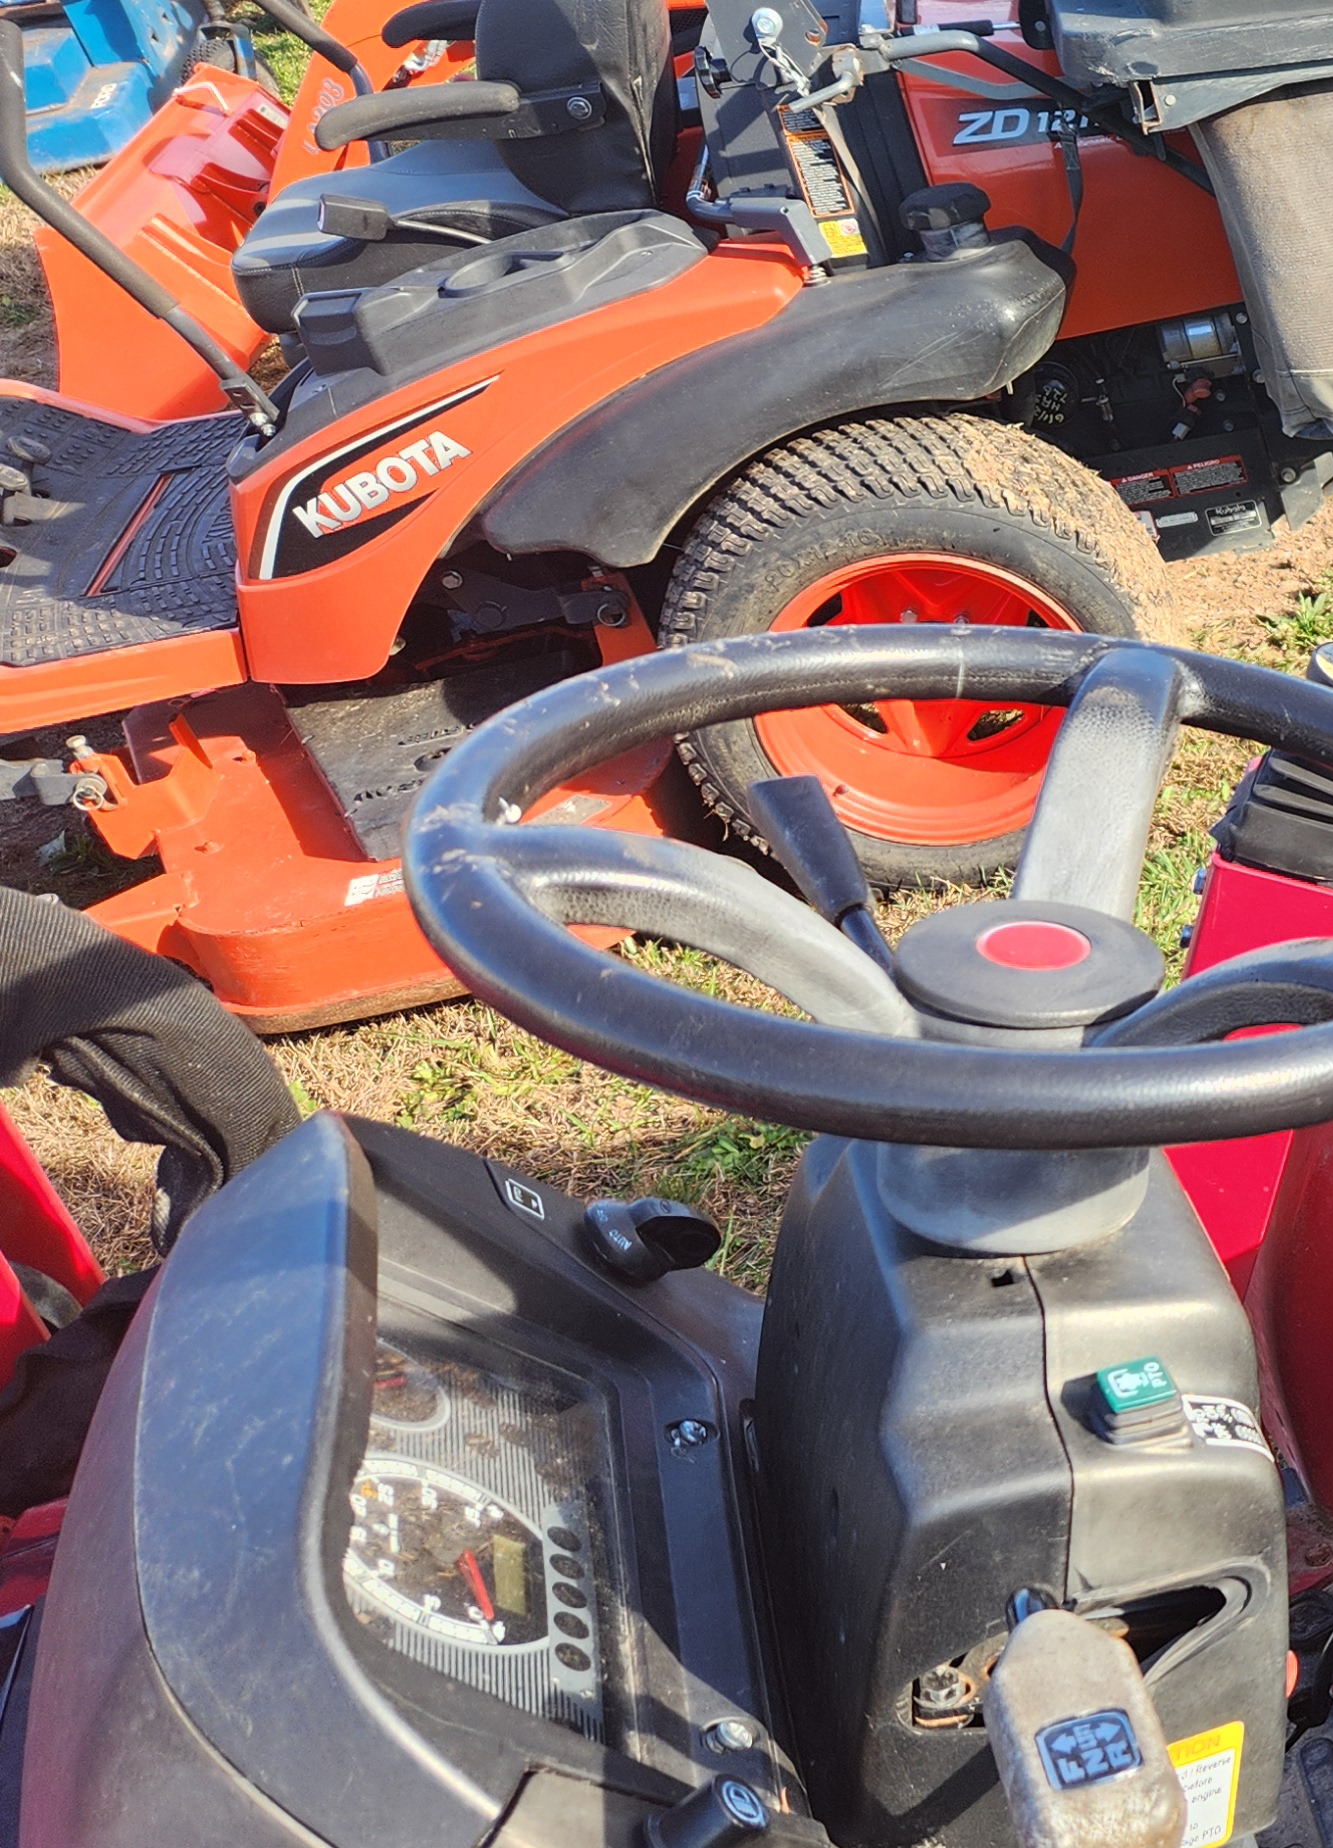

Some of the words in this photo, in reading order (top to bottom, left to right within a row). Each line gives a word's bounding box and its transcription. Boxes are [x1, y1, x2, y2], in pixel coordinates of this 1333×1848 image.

[953, 107, 1031, 146] ZD
[1126, 472, 1154, 482] DANGER
[1193, 459, 1221, 469] PELIGRO
[292, 430, 473, 539] KUBOTA
[1143, 1361, 1168, 1389] PTO
